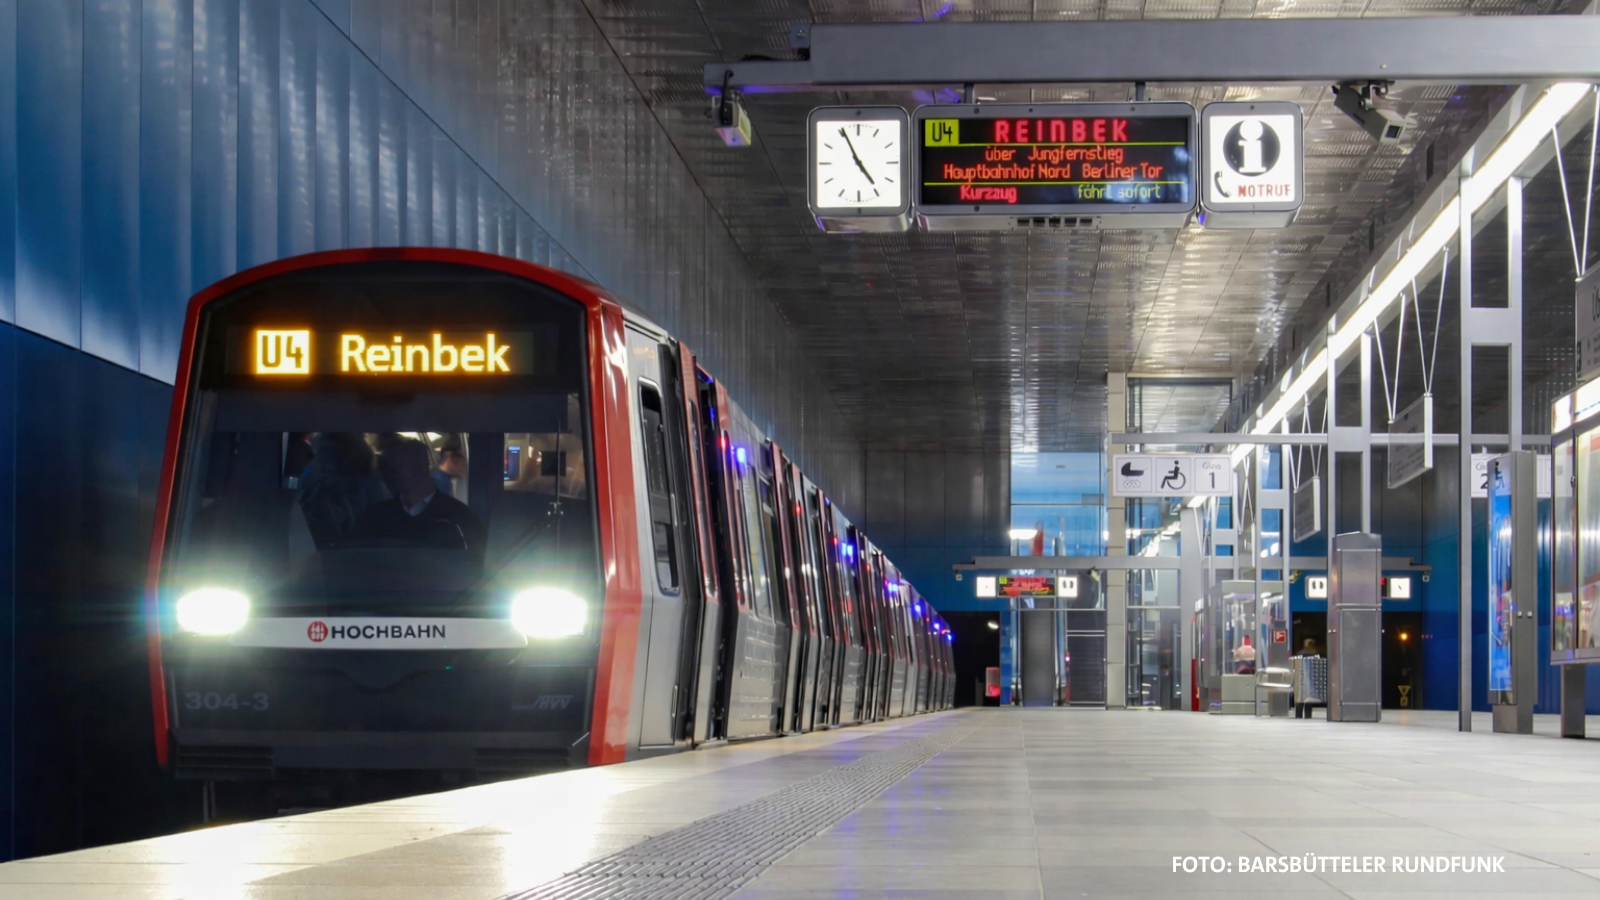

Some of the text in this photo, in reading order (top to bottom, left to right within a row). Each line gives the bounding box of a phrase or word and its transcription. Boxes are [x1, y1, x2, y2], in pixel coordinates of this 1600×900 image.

[932, 122, 953, 143] U4
[994, 119, 1127, 142] REINBEK
[985, 145, 1123, 164] über Jungfernstieg
[944, 162, 1163, 182] Hauptbahnhof Nord Berliner Tor
[960, 185, 1017, 203] Kurzzug
[1118, 184, 1161, 199] sofort
[1238, 184, 1291, 197] NOTRUF
[262, 333, 510, 372] U4 Reinbek
[1209, 472, 1215, 489] 1
[331, 625, 446, 639] HOCHBAHN
[185, 692, 269, 710] 304-3
